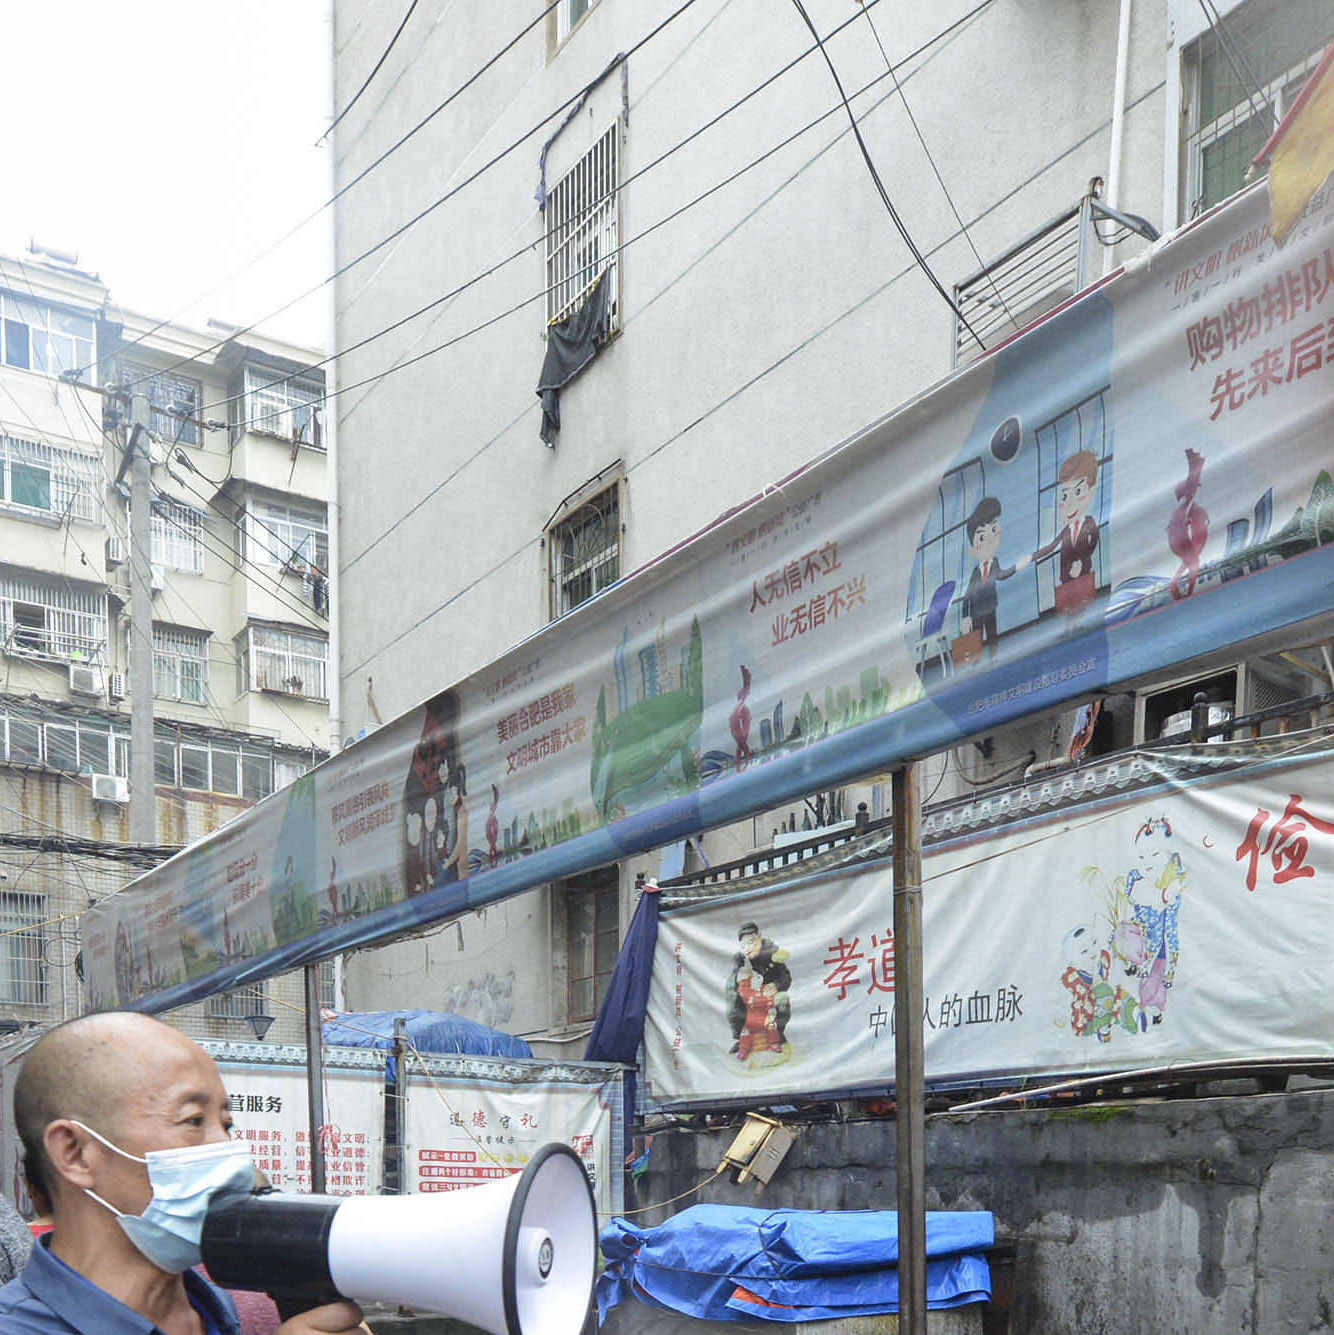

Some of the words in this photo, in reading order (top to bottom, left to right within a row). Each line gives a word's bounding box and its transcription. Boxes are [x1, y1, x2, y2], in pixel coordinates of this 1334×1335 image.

[750, 540, 843, 614] 人无信不立
[771, 573, 867, 647] 业无信不兴
[497, 682, 576, 745] 美丽合肥是我家
[506, 715, 586, 776] 文明城市靠大家
[823, 928, 896, 1001] 孝道
[868, 984, 1025, 1039] 中人的血脉
